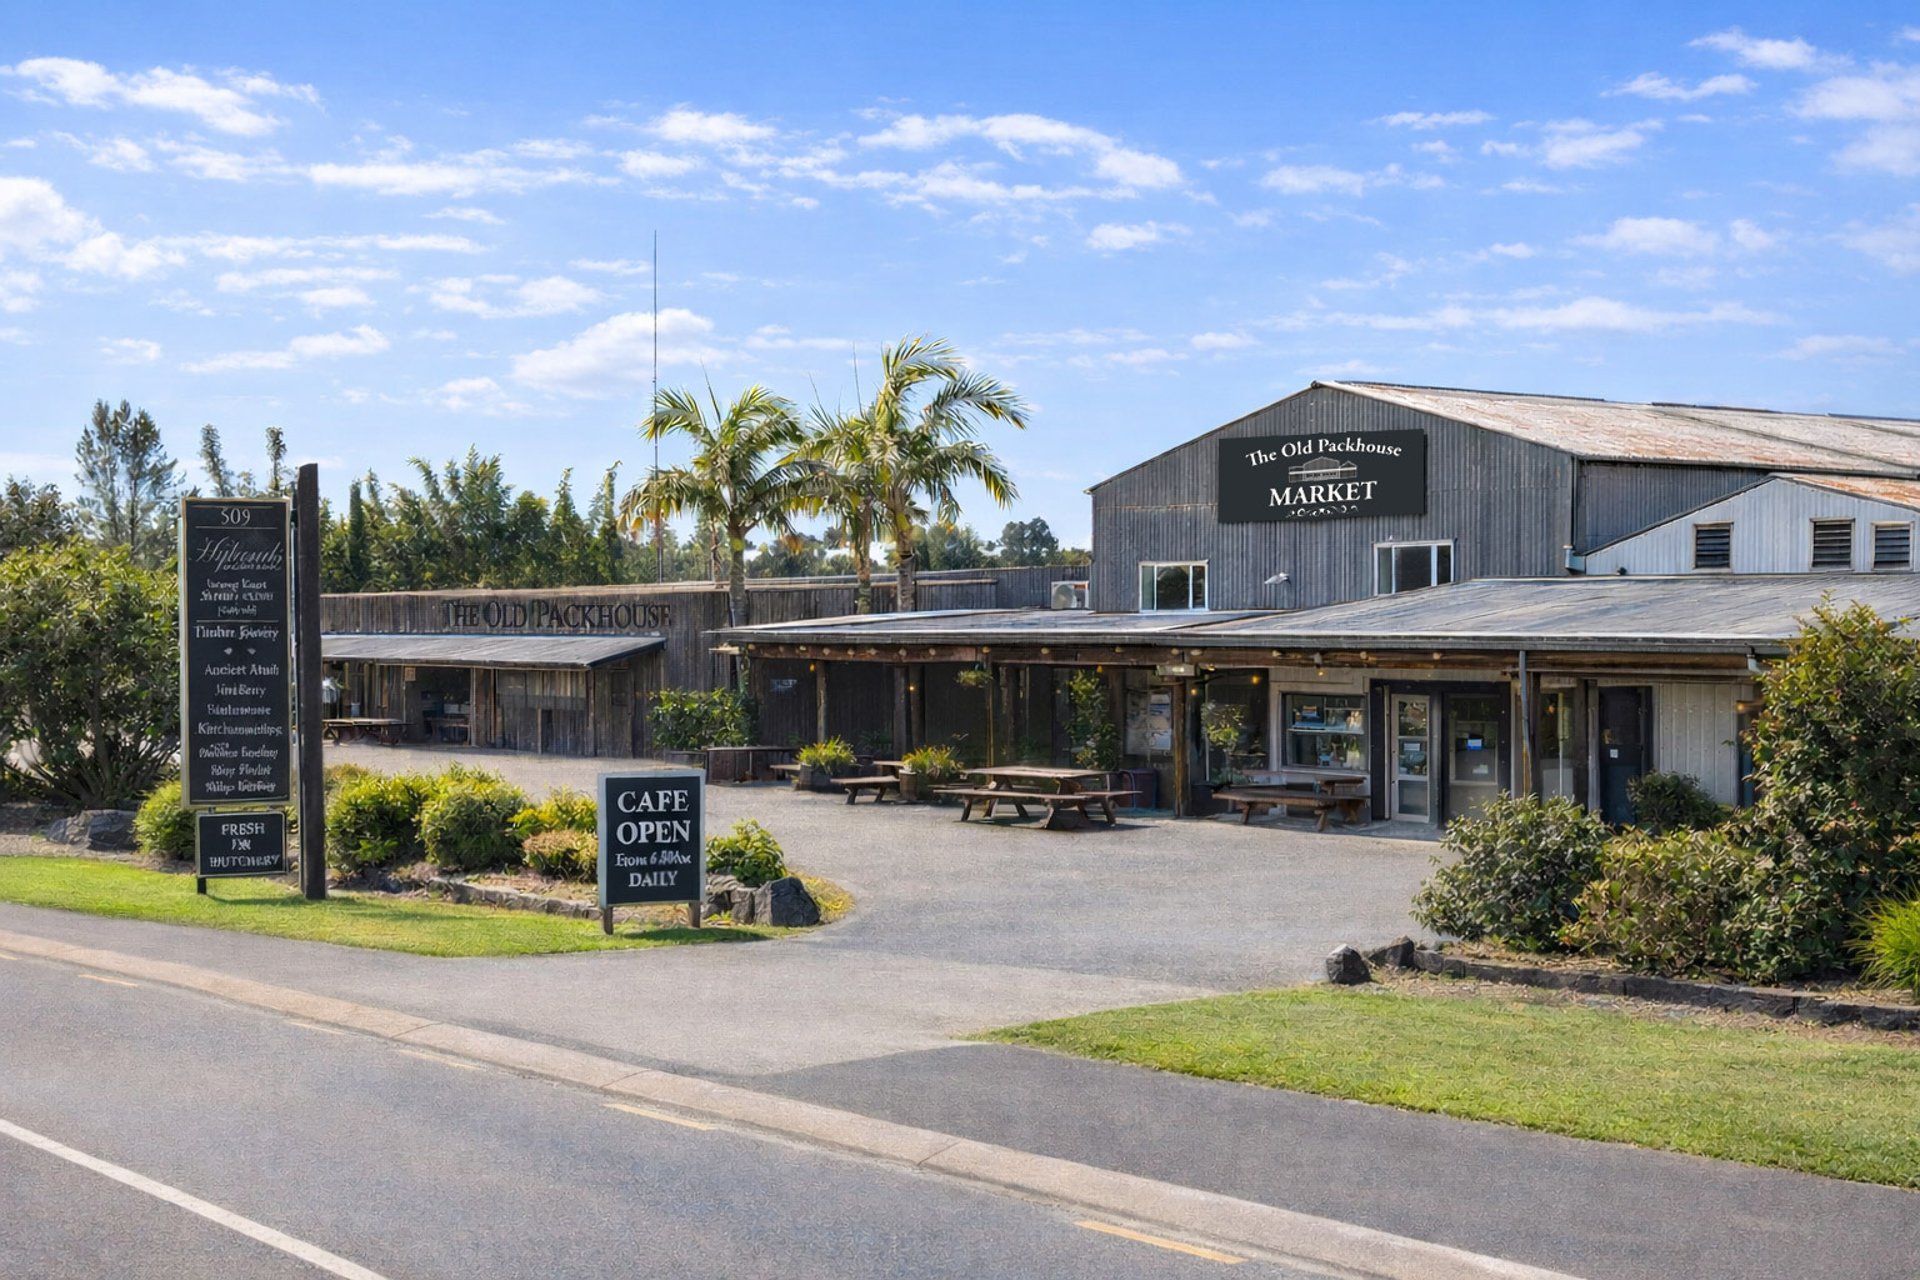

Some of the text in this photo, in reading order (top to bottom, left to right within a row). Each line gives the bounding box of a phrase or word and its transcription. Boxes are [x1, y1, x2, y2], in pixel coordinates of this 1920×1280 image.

[1246, 437, 1402, 467] The Old Packhouse
[1269, 480, 1378, 507] MARKET
[221, 507, 251, 526] 509
[617, 789, 690, 813] CAFE
[221, 822, 265, 836] FRESH
[616, 820, 691, 845] OPEN
[628, 870, 678, 887] DAILY
